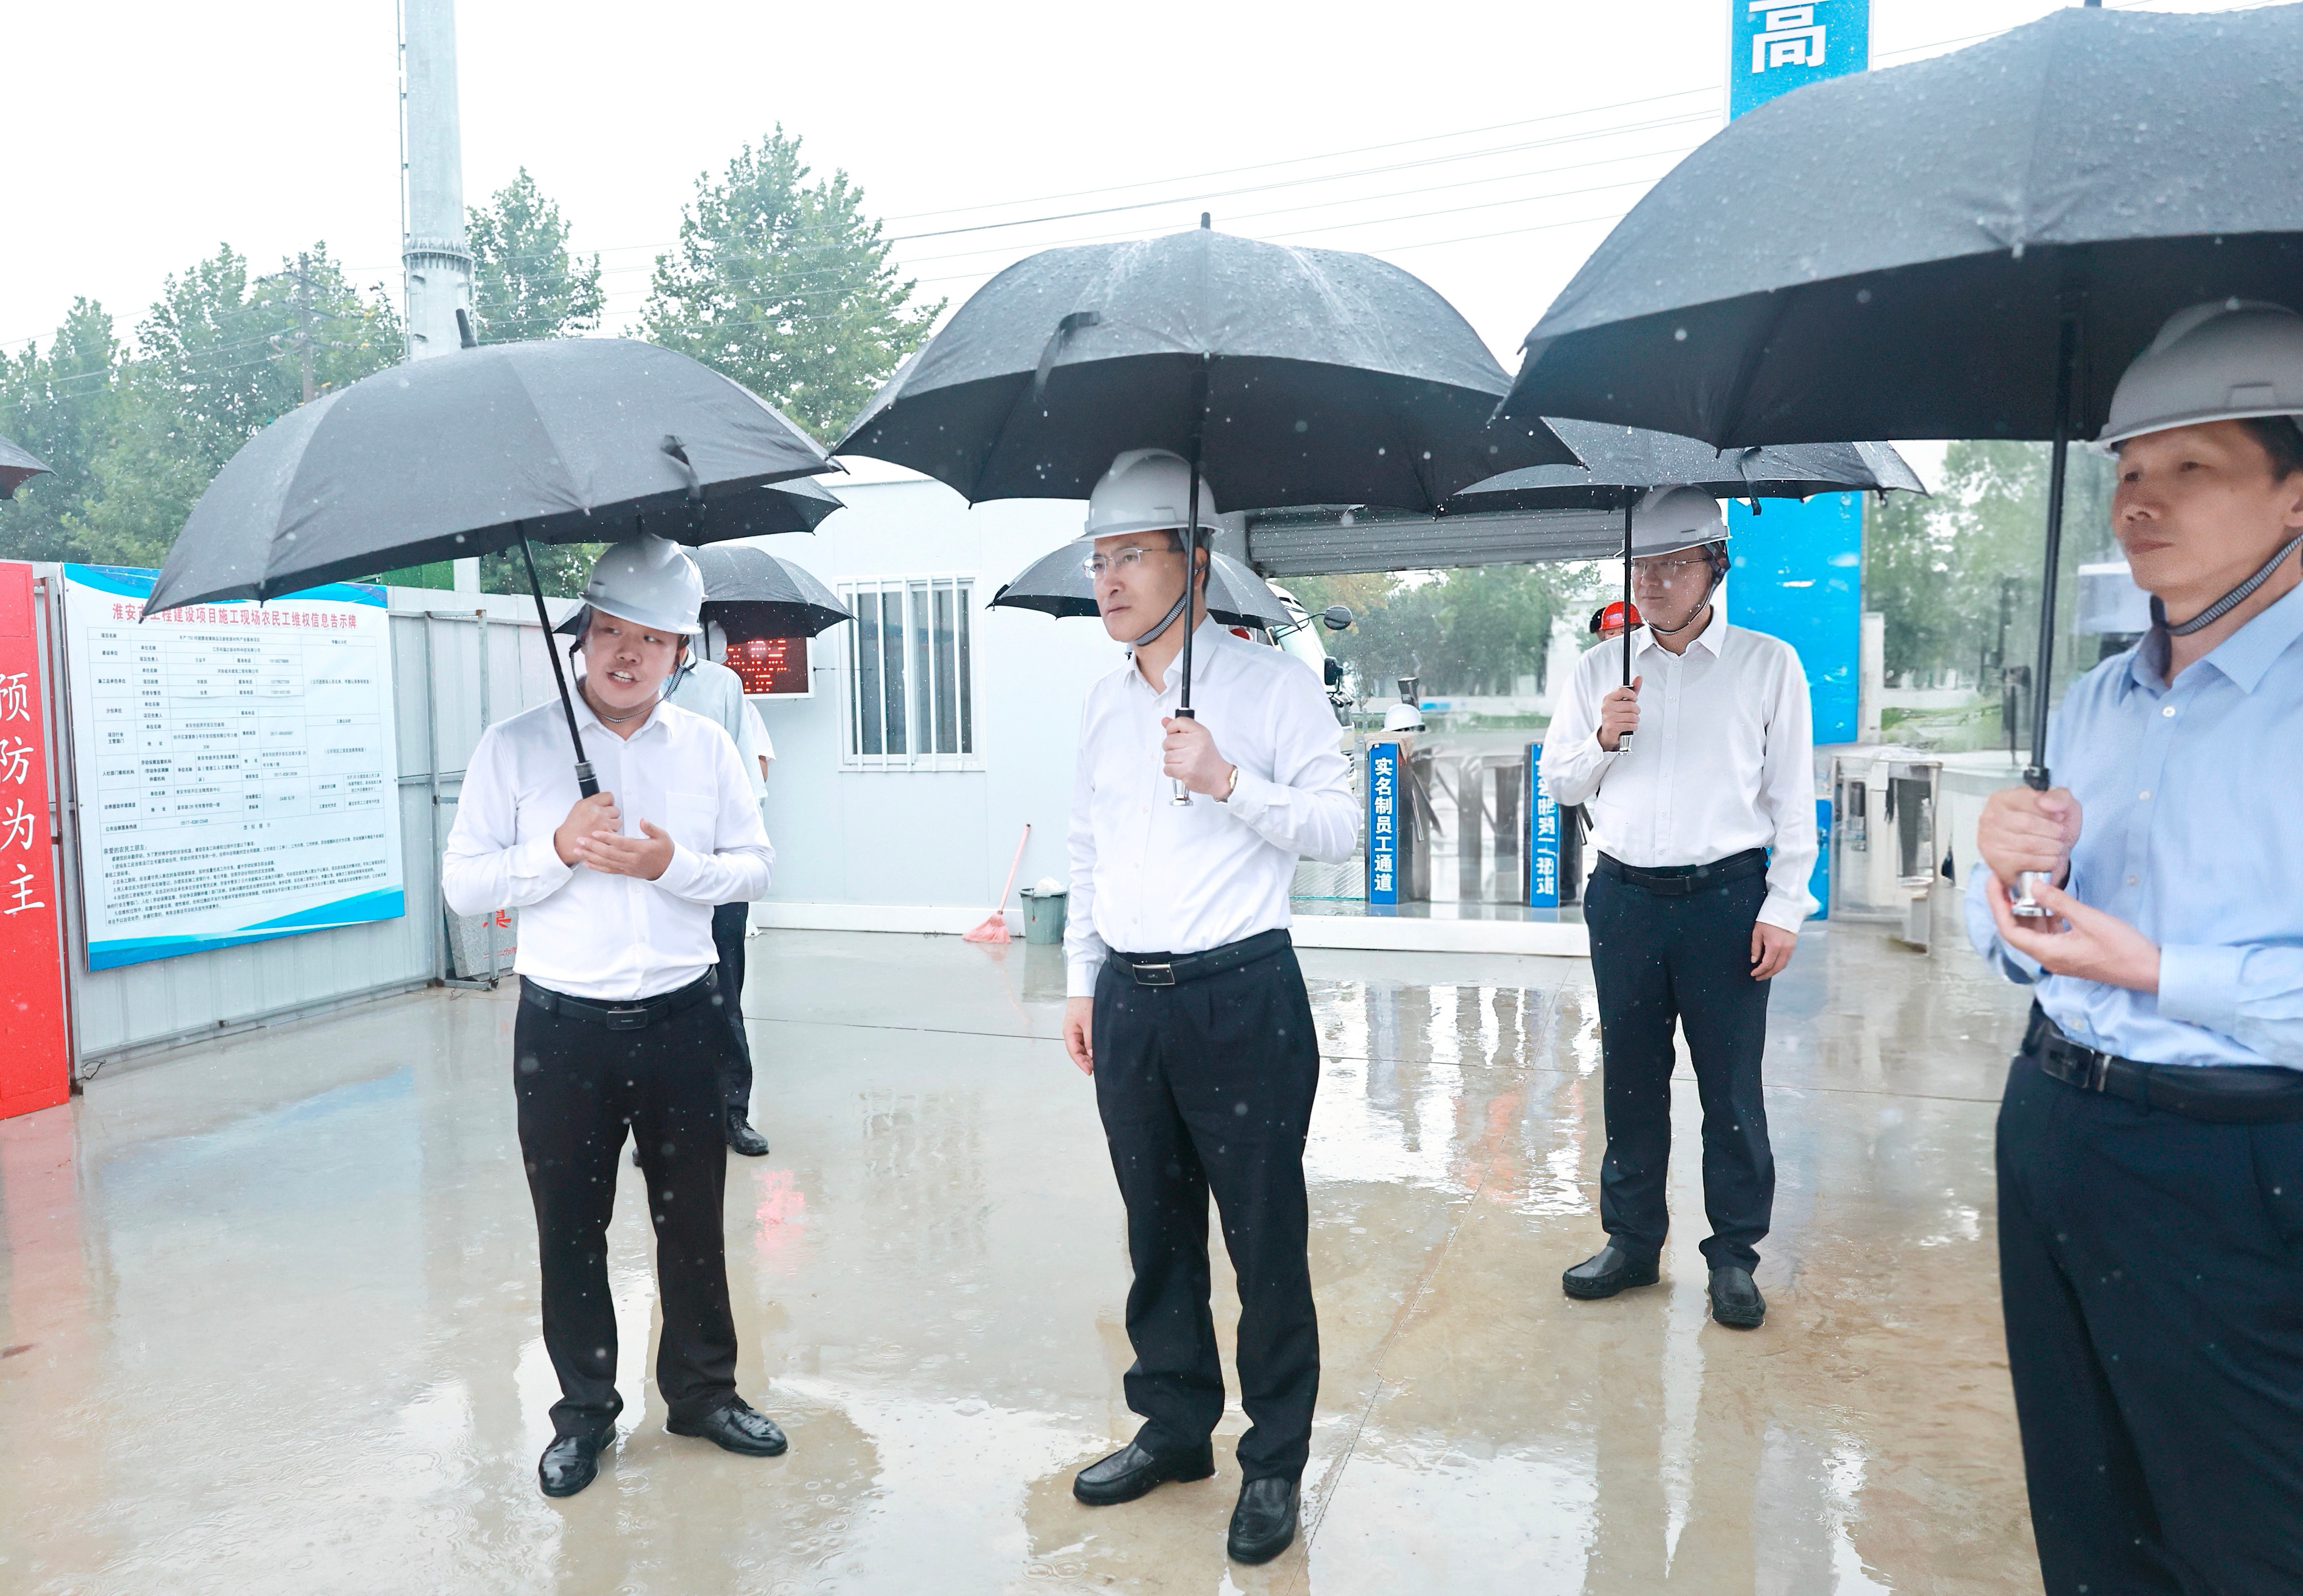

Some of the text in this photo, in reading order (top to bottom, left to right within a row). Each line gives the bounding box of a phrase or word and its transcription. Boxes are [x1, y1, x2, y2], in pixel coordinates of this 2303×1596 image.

[1749, 0, 1830, 74] 高
[0, 672, 45, 915] 预防为主
[1374, 757, 1393, 891] 实名制员工通道
[104, 844, 147, 855] 亲爱的农民工朋友:
